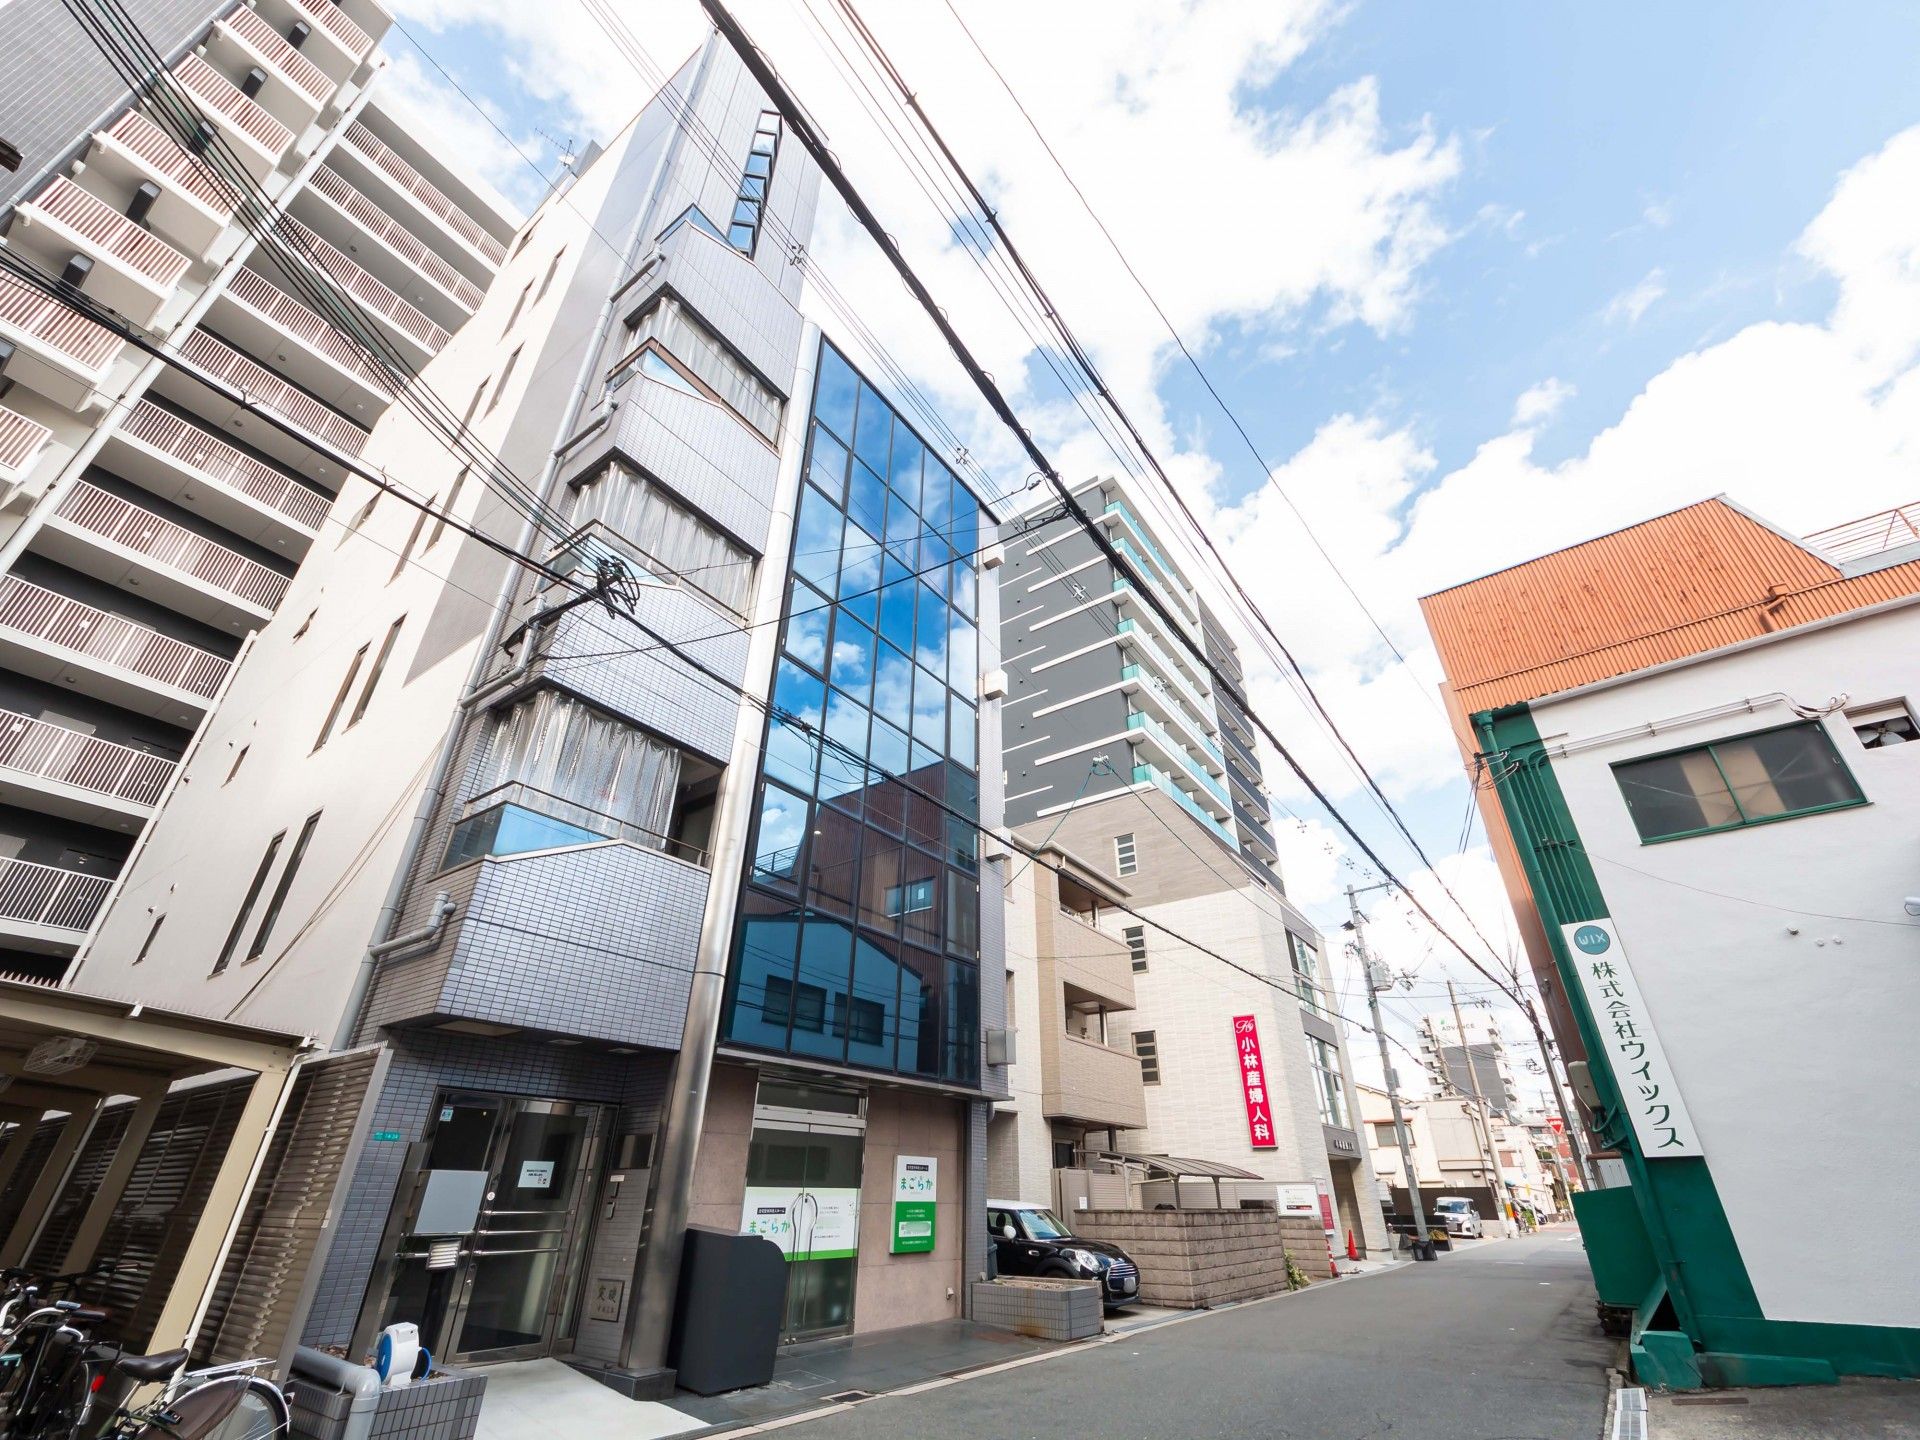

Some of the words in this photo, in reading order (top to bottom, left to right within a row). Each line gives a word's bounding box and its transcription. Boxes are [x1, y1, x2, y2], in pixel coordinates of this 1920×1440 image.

[1577, 933, 1607, 945] WIX
[1241, 1036, 1269, 1140] 小林産婦人科
[900, 1177, 933, 1191] まごらか
[748, 1219, 791, 1234] まごらか
